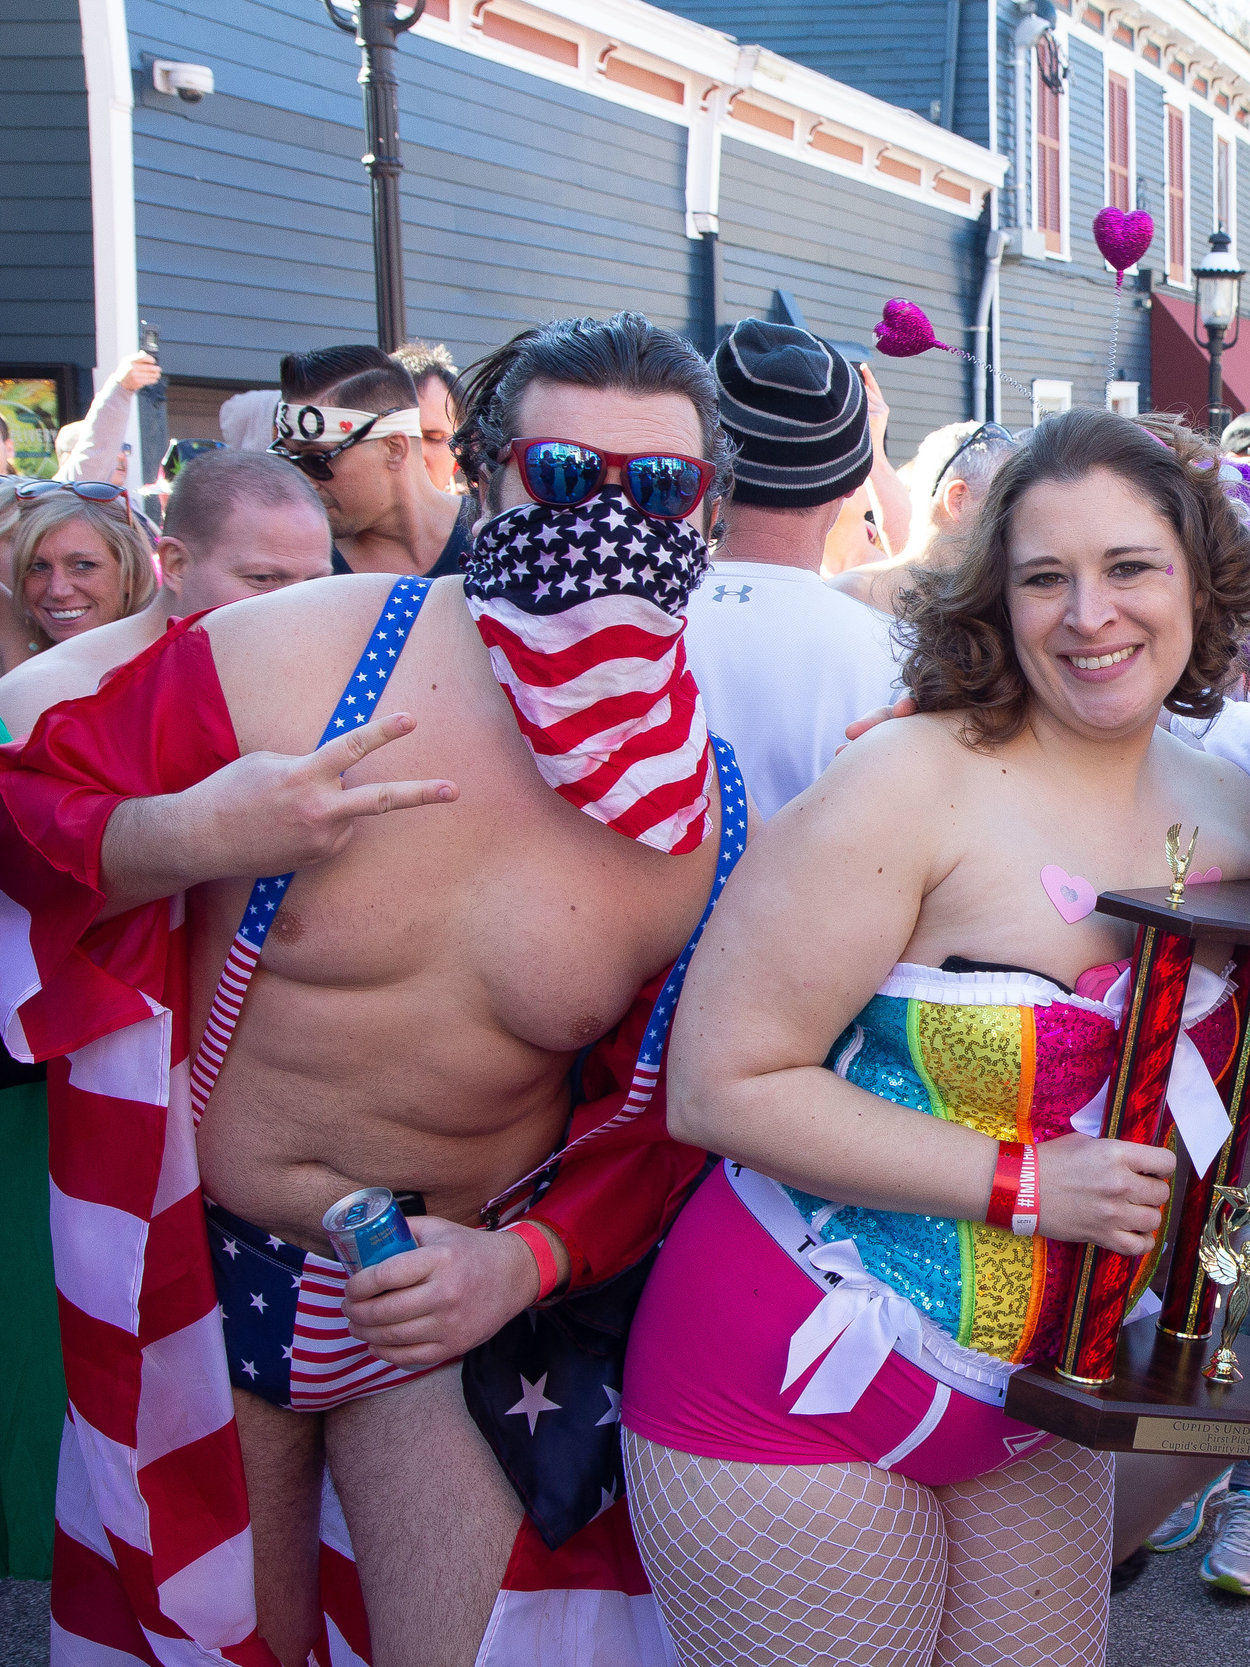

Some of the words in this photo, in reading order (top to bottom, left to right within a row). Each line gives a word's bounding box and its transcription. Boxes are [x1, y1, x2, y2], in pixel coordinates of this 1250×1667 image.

[1172, 1420, 1220, 1434] CUPID'S
[1206, 1433, 1229, 1443] First
[1161, 1439, 1198, 1452] Cupid's
[1199, 1442, 1236, 1455] Charity
